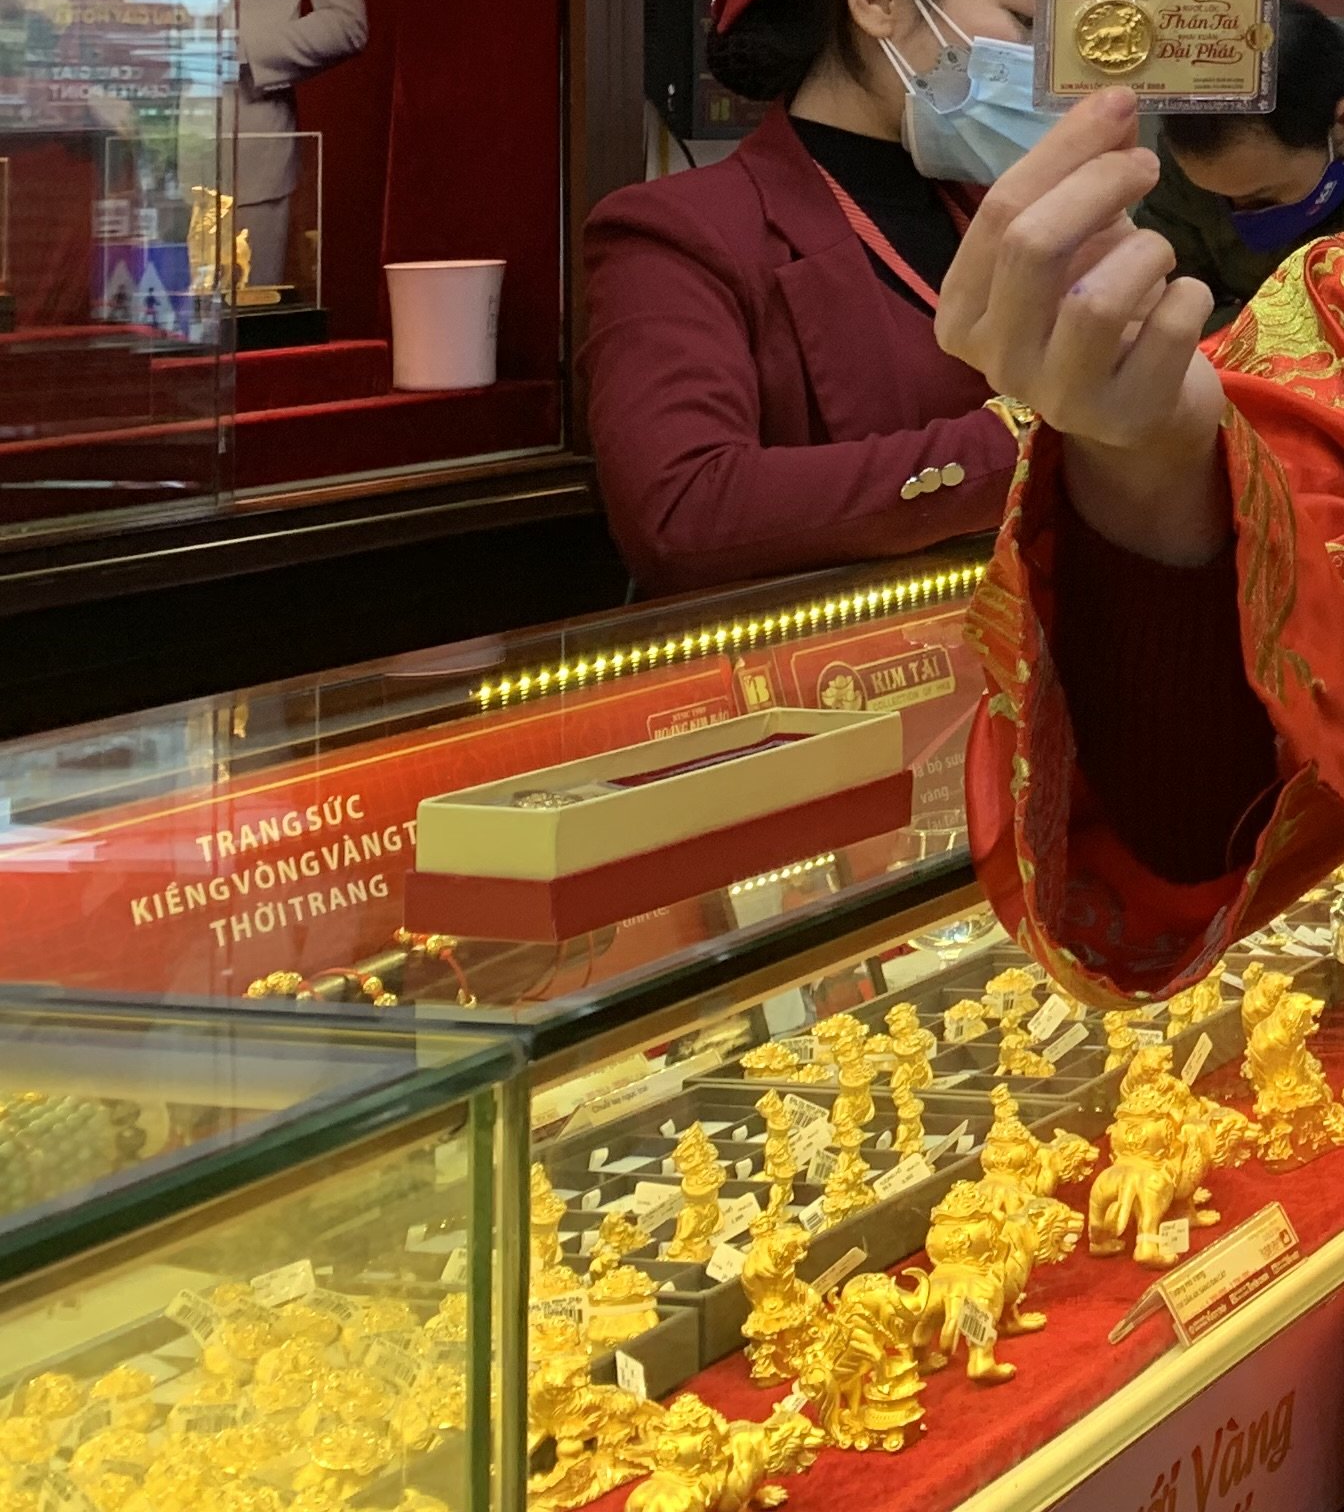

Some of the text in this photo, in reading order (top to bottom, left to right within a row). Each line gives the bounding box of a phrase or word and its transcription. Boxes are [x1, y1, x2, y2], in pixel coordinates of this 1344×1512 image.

[1158, 43, 1240, 63] Đại Phát
[870, 654, 940, 694] KIM TÀI
[196, 794, 364, 863] TRANG SỨC
[130, 824, 403, 926] KIỀNG VÒNG VÀNG
[209, 874, 389, 948] THỜI TRANG
[1191, 1390, 1295, 1512] Vàng
